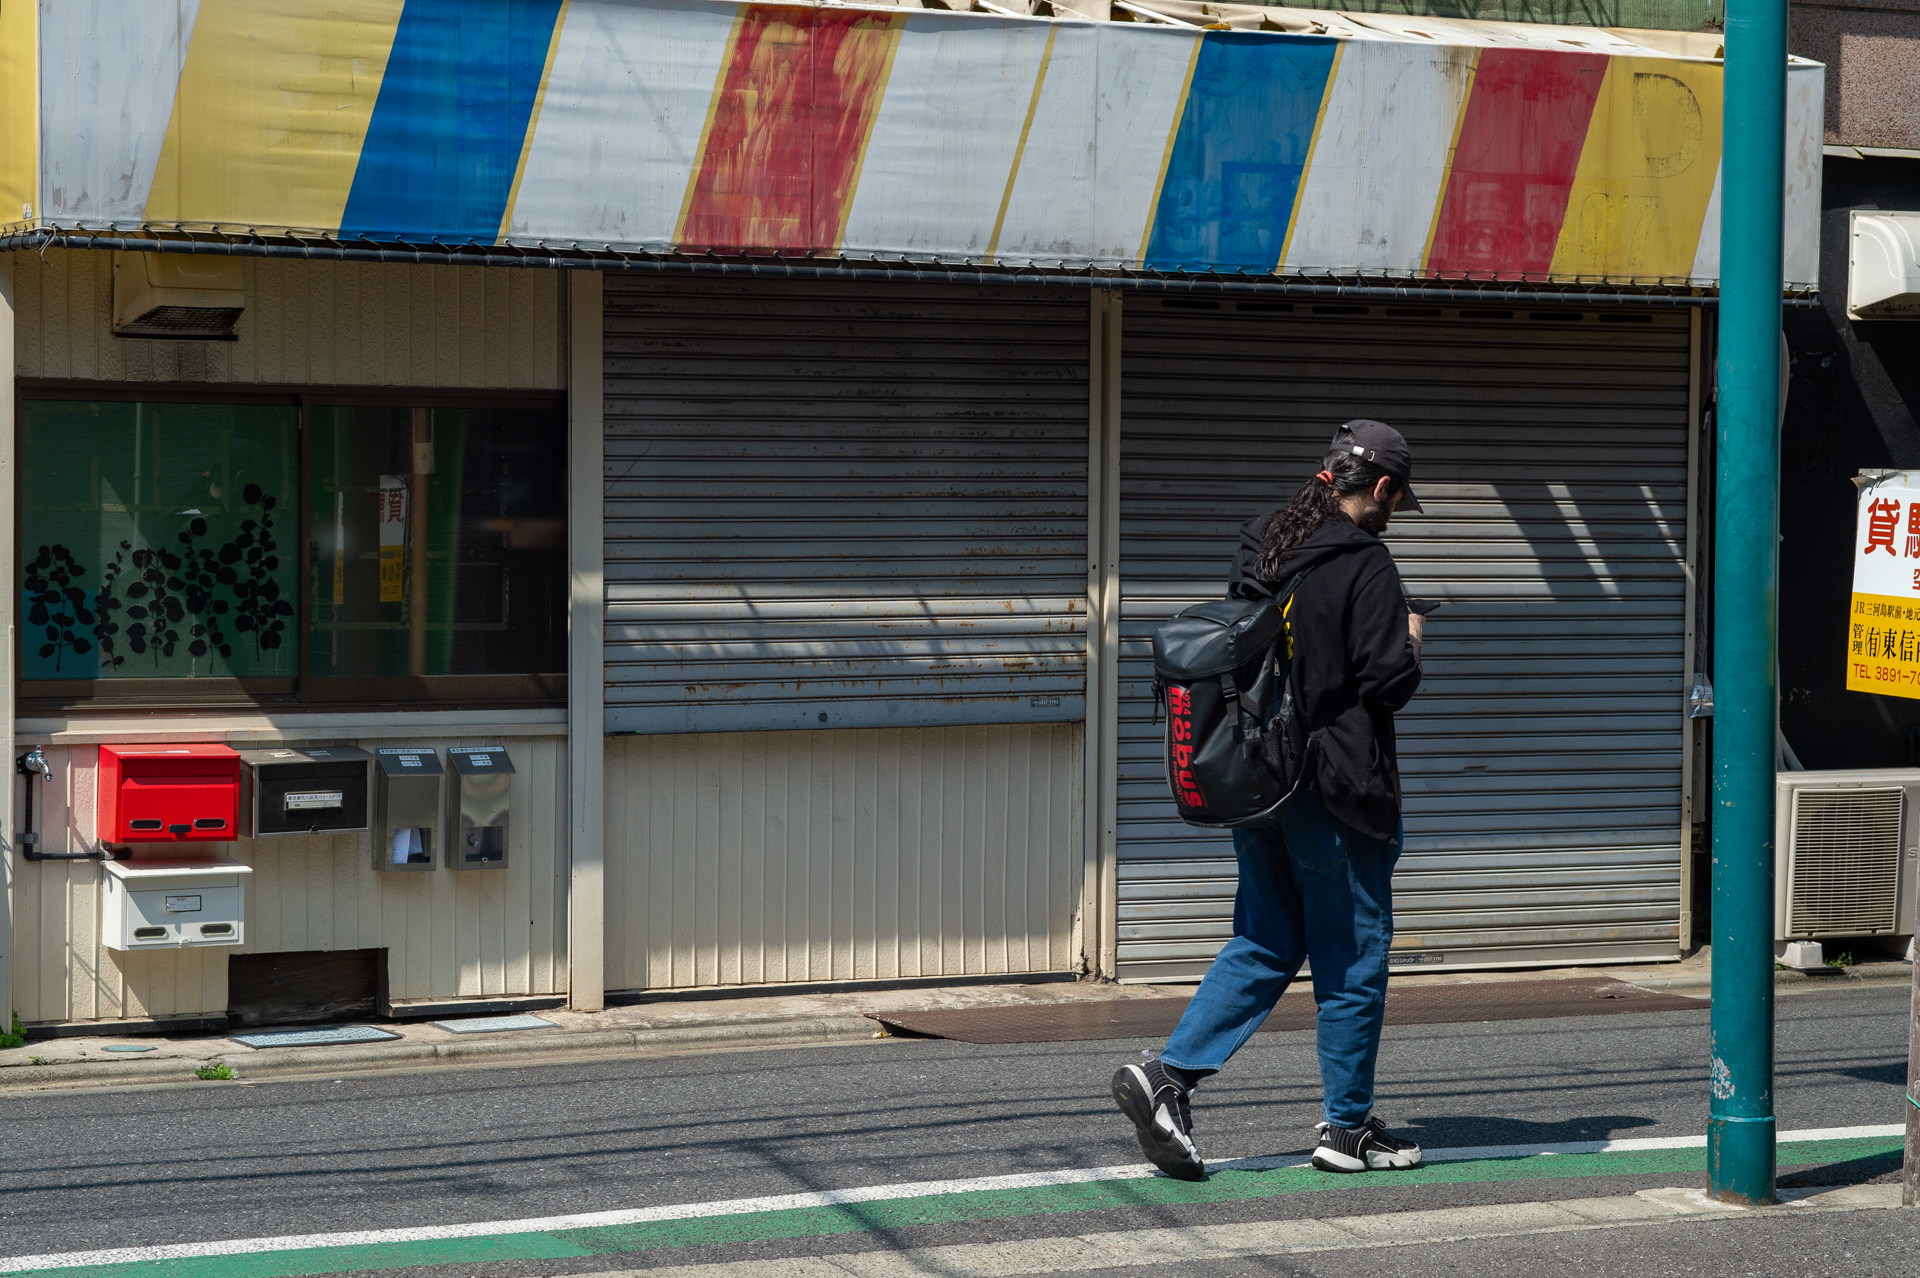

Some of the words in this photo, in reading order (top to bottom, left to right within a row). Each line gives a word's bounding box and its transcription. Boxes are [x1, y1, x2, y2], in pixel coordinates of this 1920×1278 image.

[1865, 626, 1920, 663] (有)東信
[1853, 663, 1871, 679] TEL
[1171, 687, 1202, 808] möbus
